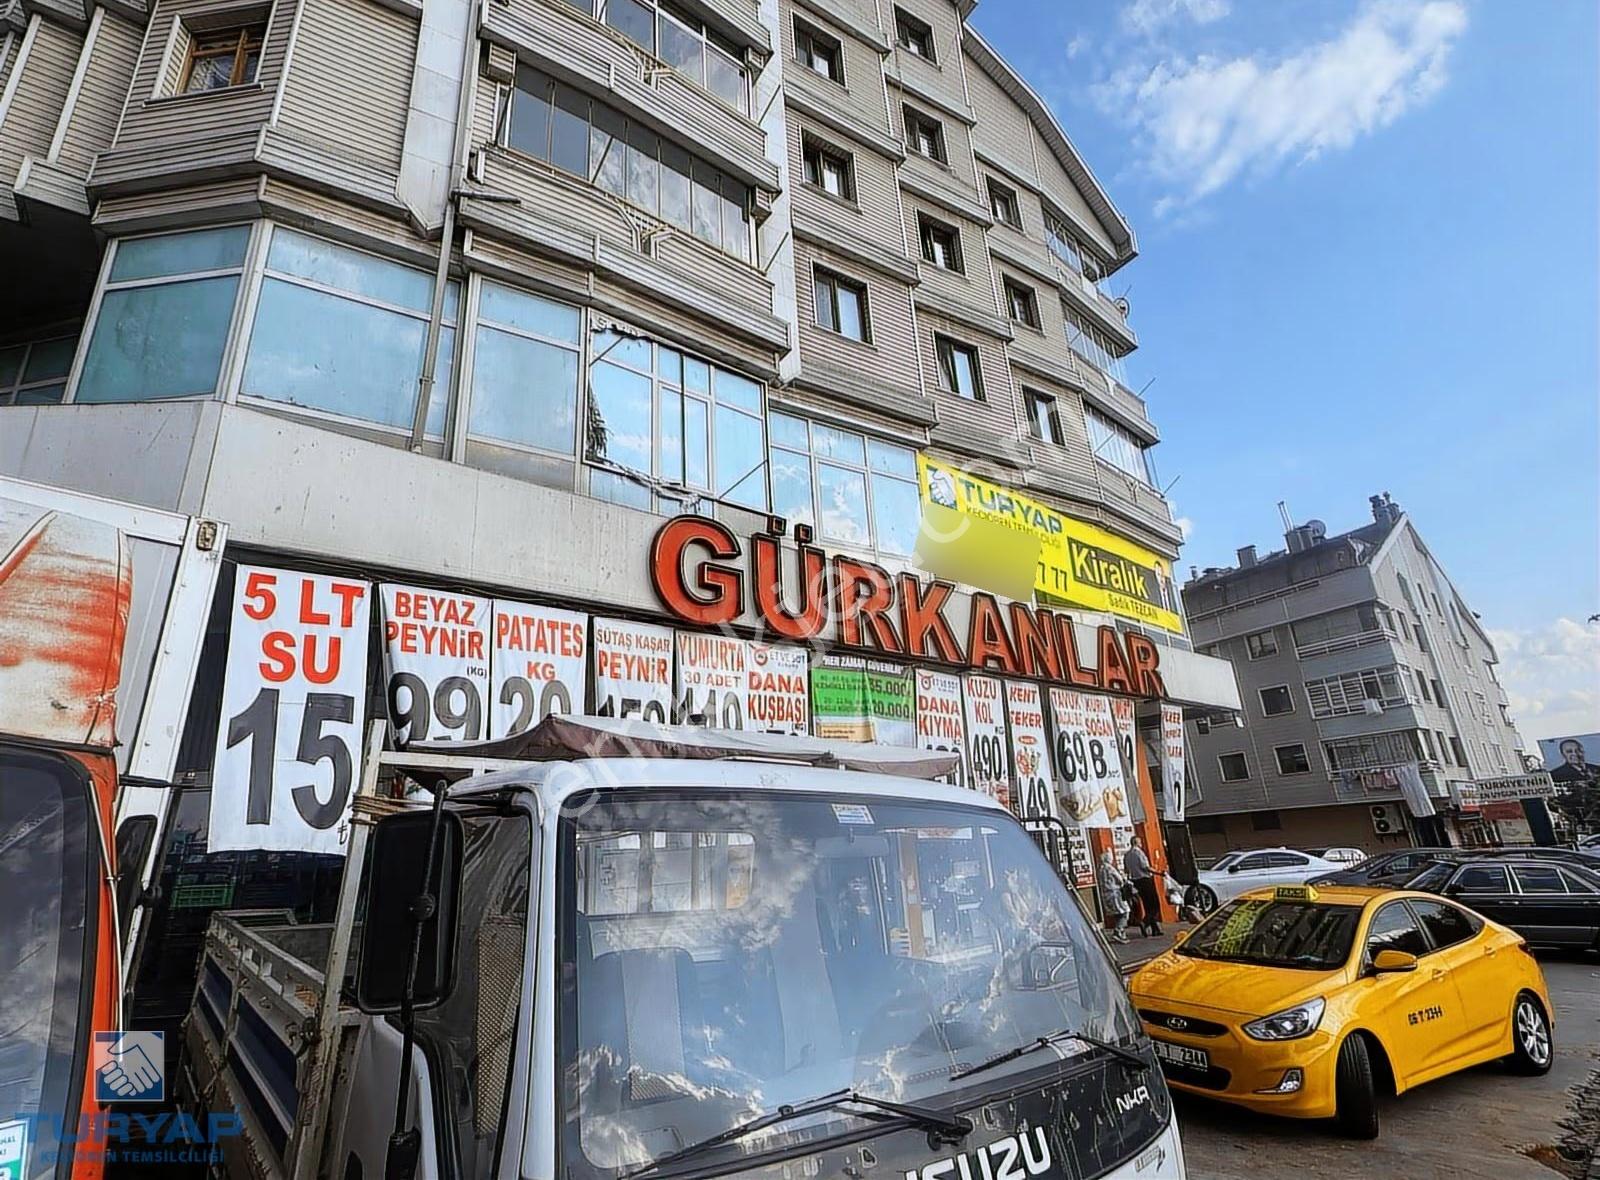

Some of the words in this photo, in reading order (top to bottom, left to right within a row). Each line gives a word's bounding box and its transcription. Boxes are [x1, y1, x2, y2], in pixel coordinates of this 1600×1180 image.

[959, 477, 1064, 534] TURYAP
[1071, 542, 1149, 600] Kiralık
[242, 572, 278, 621] 5
[299, 578, 365, 628] LT
[394, 591, 476, 627] BEYAZ
[650, 513, 1167, 698] GÜRKANLAR
[497, 612, 584, 659] PATATES
[596, 627, 633, 648] SÜTAŞ
[635, 632, 670, 654] KAŞAR
[678, 633, 745, 673] YUMURTA
[258, 630, 342, 685] SU
[526, 660, 556, 681] KG
[684, 670, 700, 685] 30
[705, 671, 742, 689] ADET
[748, 671, 806, 695] DANA
[967, 678, 997, 701] KUZU
[1009, 686, 1037, 704] KENT
[387, 672, 482, 742] 99
[747, 693, 806, 728] KUŞBAŞI
[918, 695, 960, 716] DANA
[975, 701, 994, 725] KOL
[918, 714, 962, 739] KIYMA
[226, 686, 355, 830] 15
[973, 733, 1003, 782] 490
[1056, 730, 1088, 782] 69
[904, 1126, 1051, 1180] SUZU
